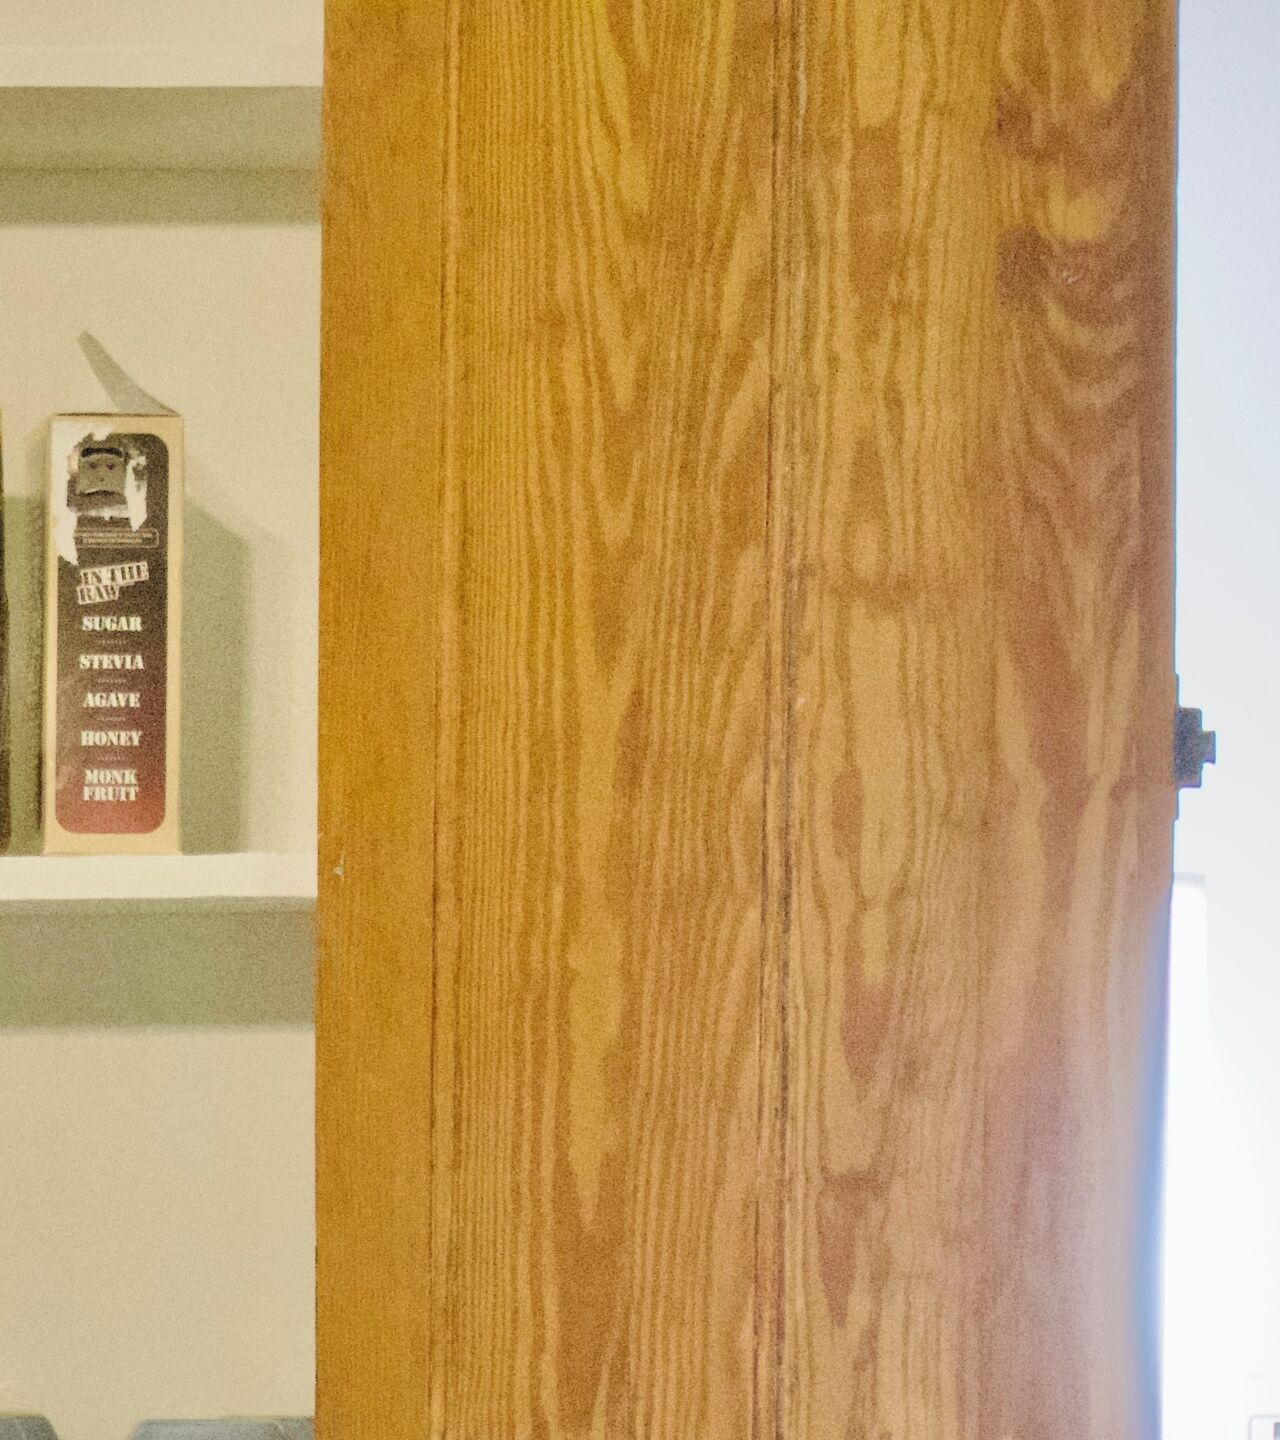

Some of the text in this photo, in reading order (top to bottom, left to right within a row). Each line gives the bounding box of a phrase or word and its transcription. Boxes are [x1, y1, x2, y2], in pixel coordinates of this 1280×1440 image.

[82, 615, 142, 632] SUGAR
[79, 653, 144, 670] STEVIA
[82, 692, 141, 708] AGAVE
[81, 730, 142, 747] HONEY
[85, 768, 138, 785] MONK
[83, 785, 140, 802] FRUIT
